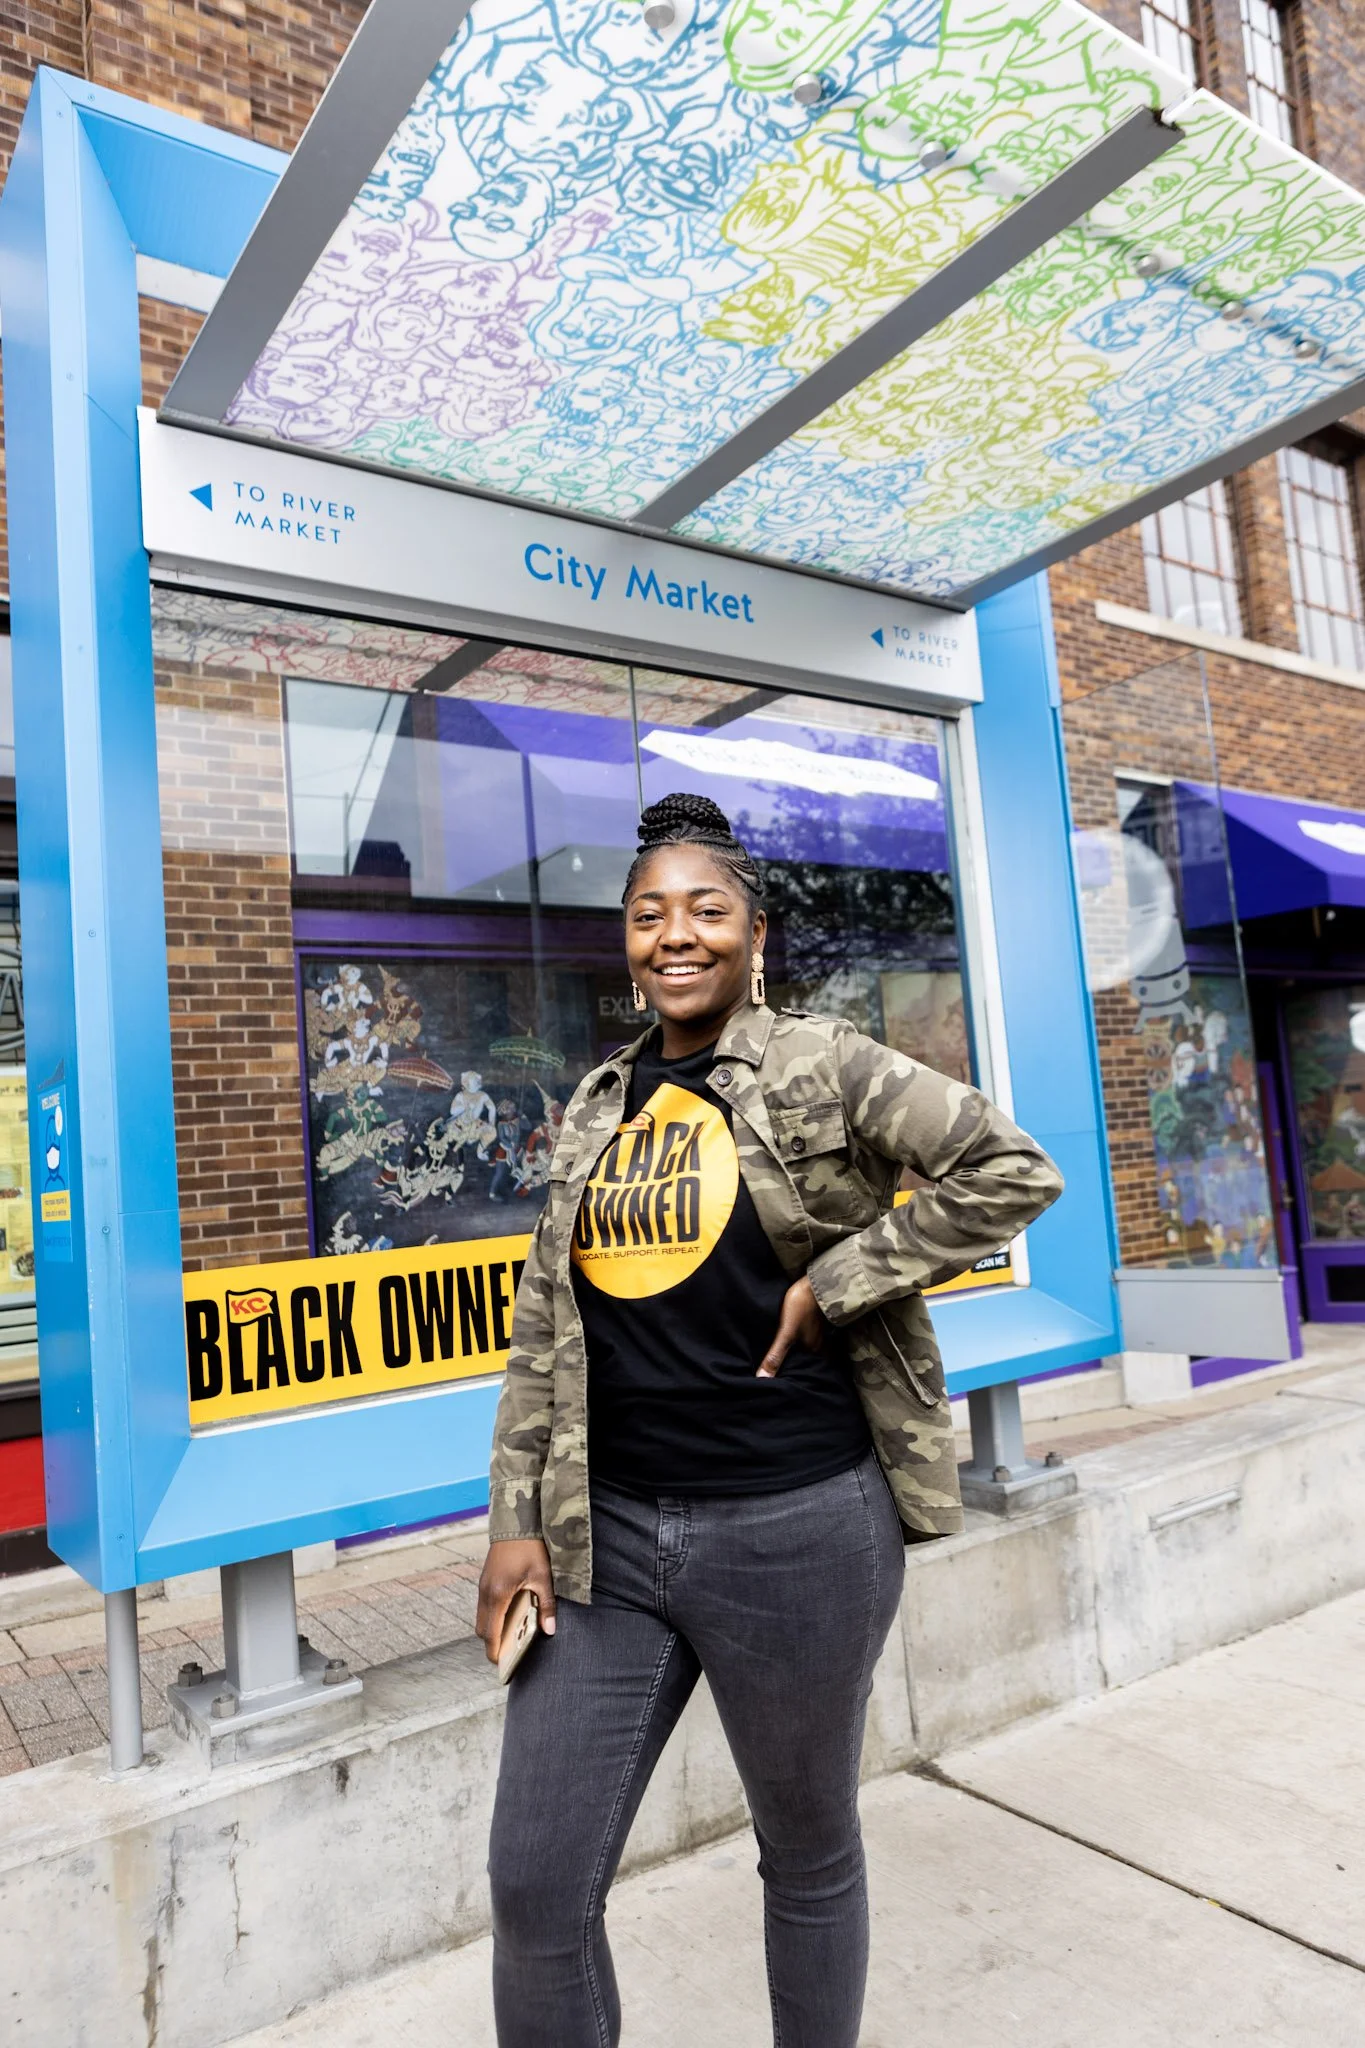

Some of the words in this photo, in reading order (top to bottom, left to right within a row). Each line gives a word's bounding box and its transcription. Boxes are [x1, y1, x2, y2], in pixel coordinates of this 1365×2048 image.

[233, 481, 265, 502] TO
[282, 492, 355, 521] RIVER
[235, 509, 341, 544] MARKET
[524, 543, 607, 600] City
[625, 564, 754, 623] Market
[893, 625, 910, 641] TO
[918, 631, 958, 650] RIVER
[896, 646, 951, 669] MARKET
[592, 1118, 704, 1184] LACK
[576, 1176, 700, 1251] OWNED
[578, 1252, 612, 1261] LOCATE.
[613, 1249, 660, 1259] SUPPORT.
[661, 1246, 702, 1255] REPEAT.
[974, 1257, 994, 1270] SCAN
[995, 1254, 1007, 1267] ME
[231, 1296, 268, 1316] KC
[185, 1280, 363, 1402] BLACK
[378, 1259, 527, 1369] OWNE
